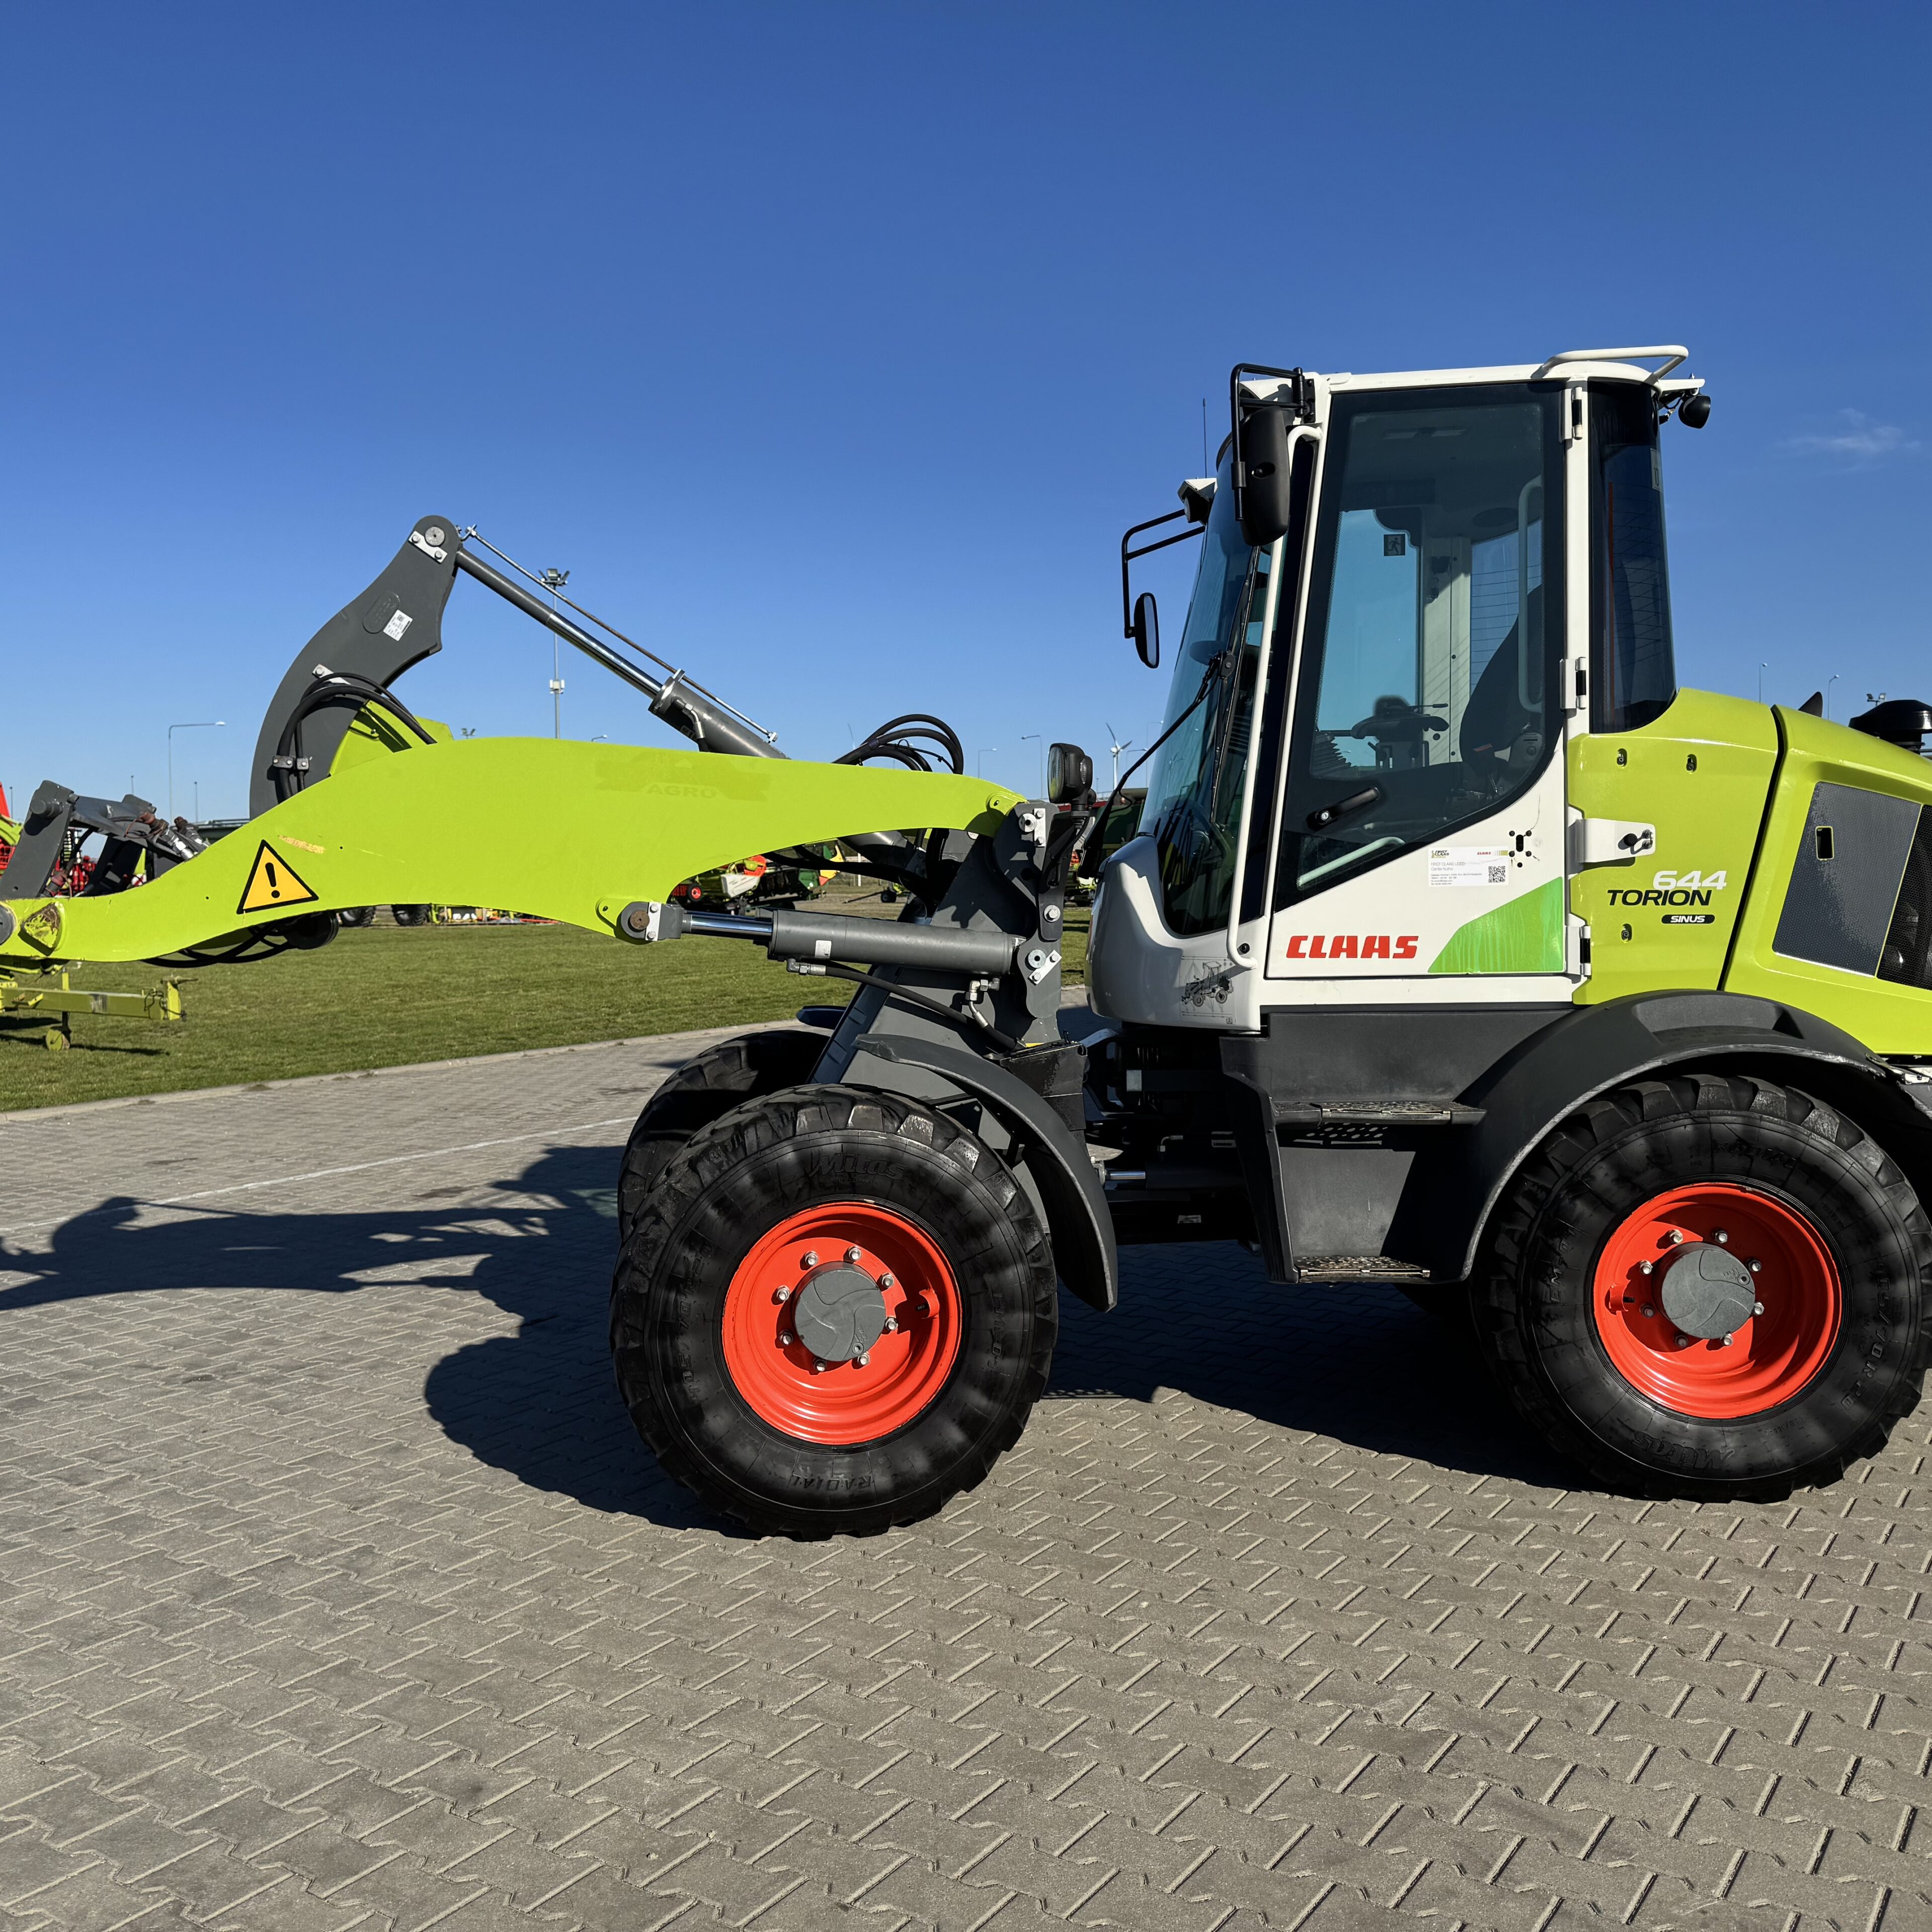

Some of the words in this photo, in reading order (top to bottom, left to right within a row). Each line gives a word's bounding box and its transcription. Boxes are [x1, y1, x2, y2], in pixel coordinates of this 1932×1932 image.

[648, 783, 716, 799] AGRO
[1653, 870, 1727, 890] 644
[1607, 890, 1712, 906] TORION
[1286, 935, 1419, 958] CLAAS
[808, 1152, 906, 1180] Mitas
[1714, 1140, 1797, 1170] RADIAL
[1550, 1228, 1576, 1302] EM-01
[1631, 1431, 1735, 1470] Mitas
[790, 1475, 872, 1491] RADIAL
